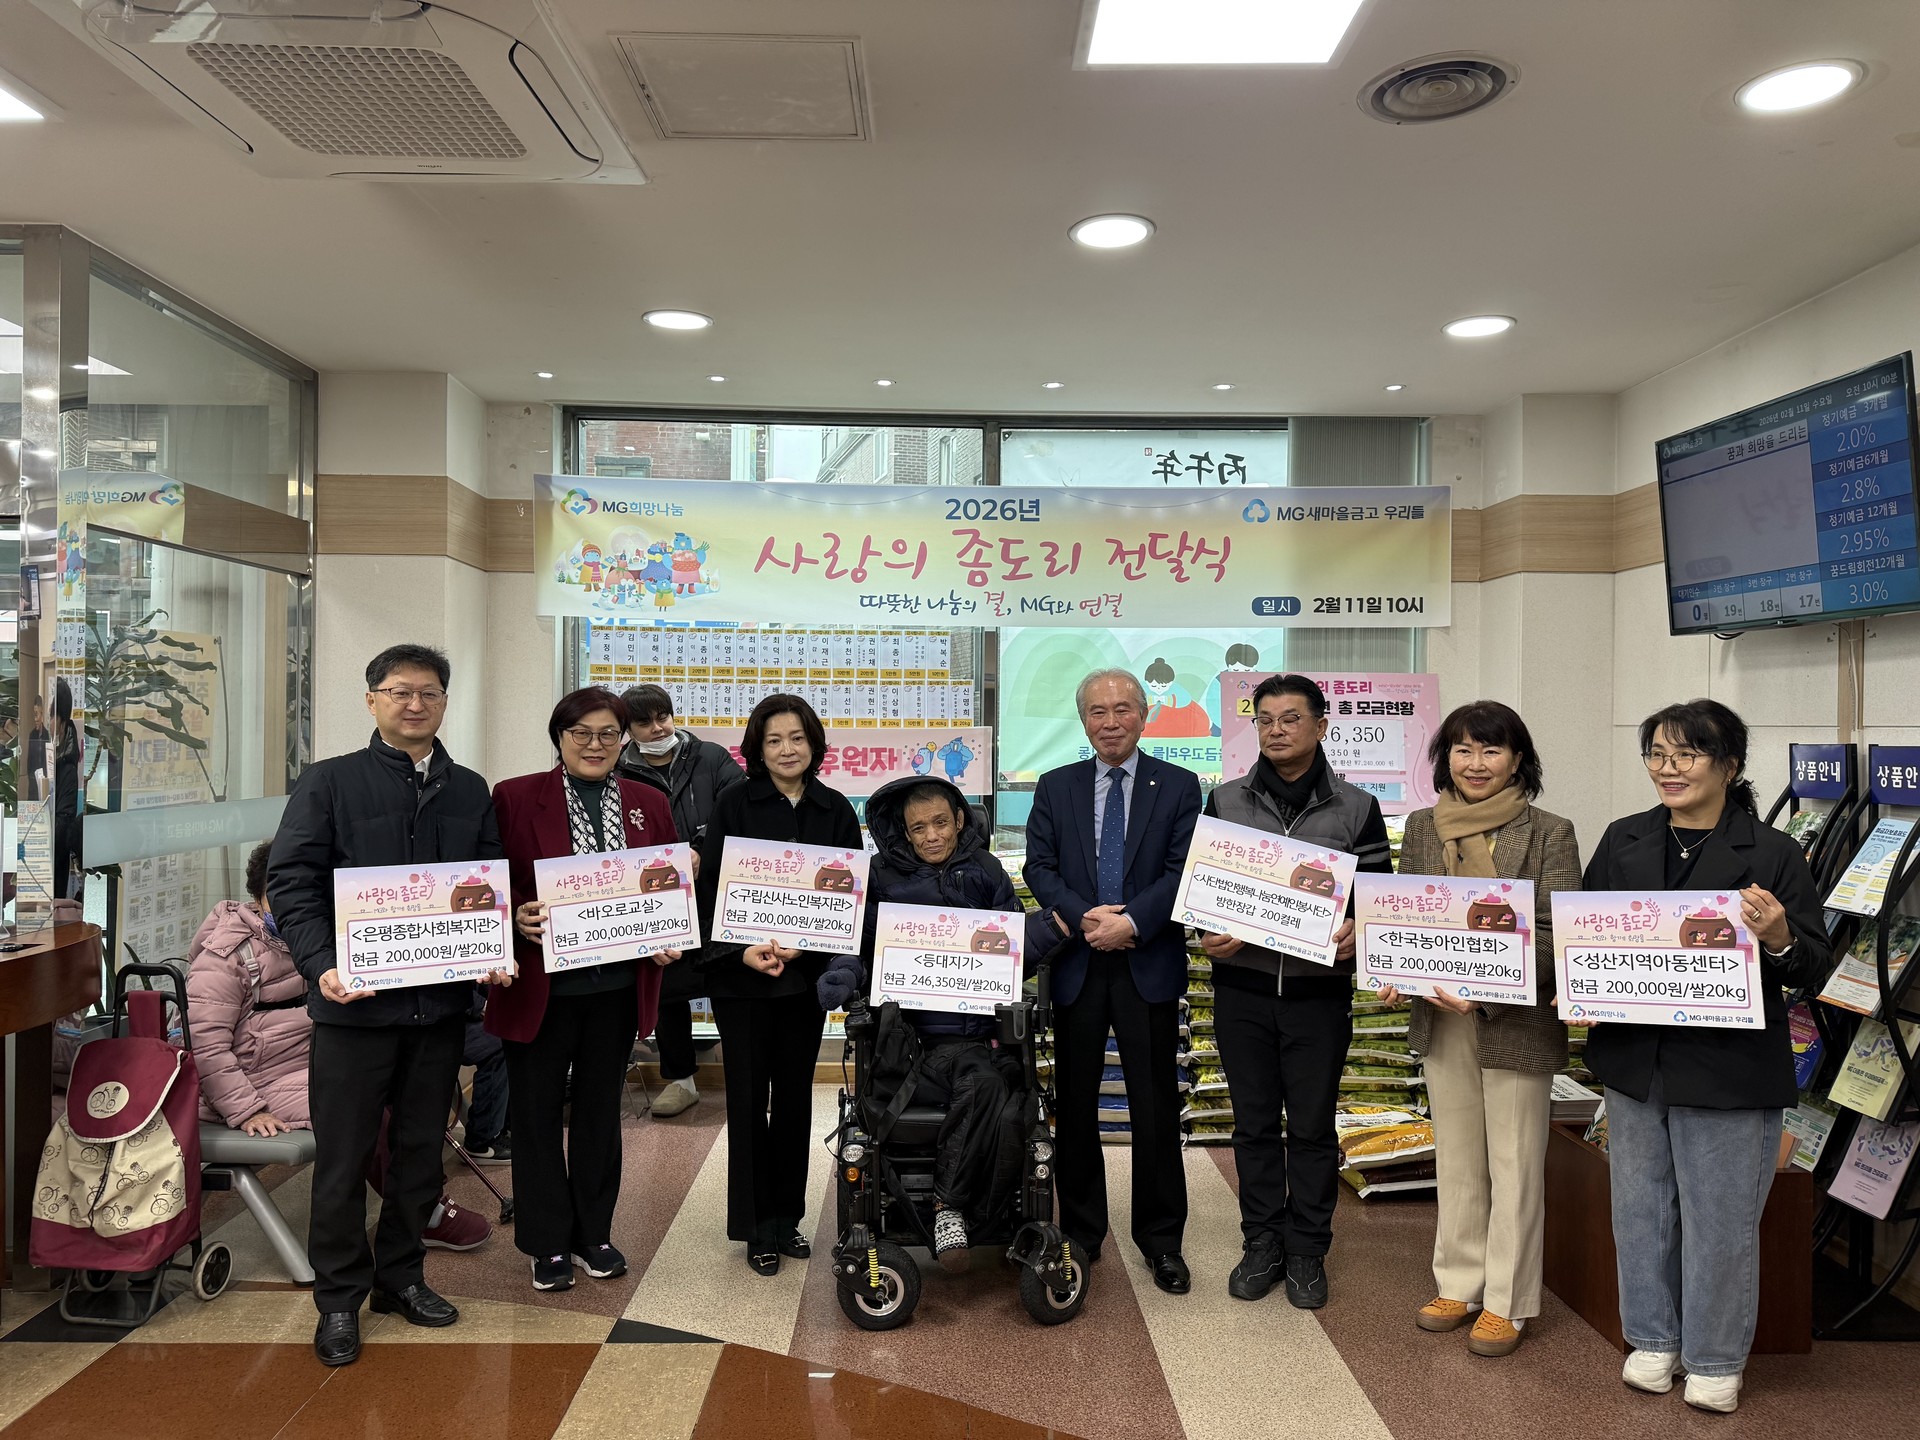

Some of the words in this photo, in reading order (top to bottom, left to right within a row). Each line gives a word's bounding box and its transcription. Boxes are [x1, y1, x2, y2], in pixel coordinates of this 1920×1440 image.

[1759, 412, 1779, 427] 2026년
[1812, 394, 1833, 409] 수요일
[1845, 385, 1861, 398] 오전
[1863, 378, 1879, 391] 10시
[1880, 372, 1898, 386] 00분
[1822, 405, 1857, 427] 정기예금
[1864, 394, 1888, 413] 3개월
[1727, 443, 1745, 461] 꿈과
[1747, 434, 1774, 454] 희망을
[1778, 425, 1807, 444] 드리는
[1837, 423, 1876, 453] 2.0%
[1841, 475, 1880, 503] 2.8%
[602, 500, 684, 517] MG희망나눔
[945, 498, 1040, 522] 2026년
[1384, 505, 1425, 520] 우리들
[1829, 508, 1865, 527] 정기예금
[1867, 501, 1898, 518] 12개월
[1840, 527, 1890, 554] 2.95%
[754, 532, 928, 583] 사랑의
[952, 528, 1081, 587] 좀도리
[1105, 531, 1231, 583] 전달식
[859, 592, 921, 614] 따뜻한
[927, 589, 977, 616] 나눔의
[1020, 596, 1075, 615] MG와
[1079, 593, 1123, 618] 연결
[1849, 580, 1889, 604] 3.0%
[1261, 599, 1292, 613] 일시
[1332, 681, 1373, 695] 좀도리
[1338, 700, 1353, 715] 총
[1356, 701, 1415, 716] 모금현황
[1795, 760, 1841, 783] 상품안내
[1370, 783, 1386, 792] 지원
[1209, 839, 1246, 859] 사랑의
[1248, 847, 1280, 868] 좀도리
[738, 857, 773, 873] 사랑의
[774, 859, 803, 875] 좀도리
[556, 873, 593, 891] 사랑의
[594, 869, 624, 887] 좀도리
[357, 885, 398, 905] 사랑의
[400, 883, 434, 903] 좀도리
[729, 888, 853, 912] <구립신사노인복지관>
[1374, 894, 1413, 912] 사랑의
[1416, 895, 1450, 913] 좀도리
[577, 898, 663, 921] <바오로교실>
[725, 908, 748, 923] 현금
[752, 912, 852, 935] 200,000원/쌀20kg
[1216, 895, 1256, 917] 방한장갑
[1260, 909, 1302, 929] 200켤레
[352, 917, 500, 943] <은평종합사회복지관>
[555, 932, 579, 948] 현금
[584, 918, 689, 942] 200,000원/쌀20kg
[893, 921, 928, 937] 사랑의
[930, 923, 959, 939] 좀도리
[1574, 913, 1618, 933] 사랑의
[1620, 913, 1658, 932] 좀도리
[351, 952, 380, 968] 현금
[385, 942, 502, 963] 200,000원/쌀20kg
[1378, 931, 1509, 955] <한국농아인협회>
[914, 953, 983, 971] <등대지기>
[1368, 954, 1394, 970] 현금
[1399, 956, 1522, 981] 200,000원/쌀20kg
[1572, 953, 1739, 974] <성산지역아동센터>
[883, 972, 906, 986] 현금
[911, 974, 1011, 995] 246,350원/쌀20kg
[1570, 978, 1599, 995] 현금
[1606, 980, 1746, 1002] 200,000원/쌀20kg
